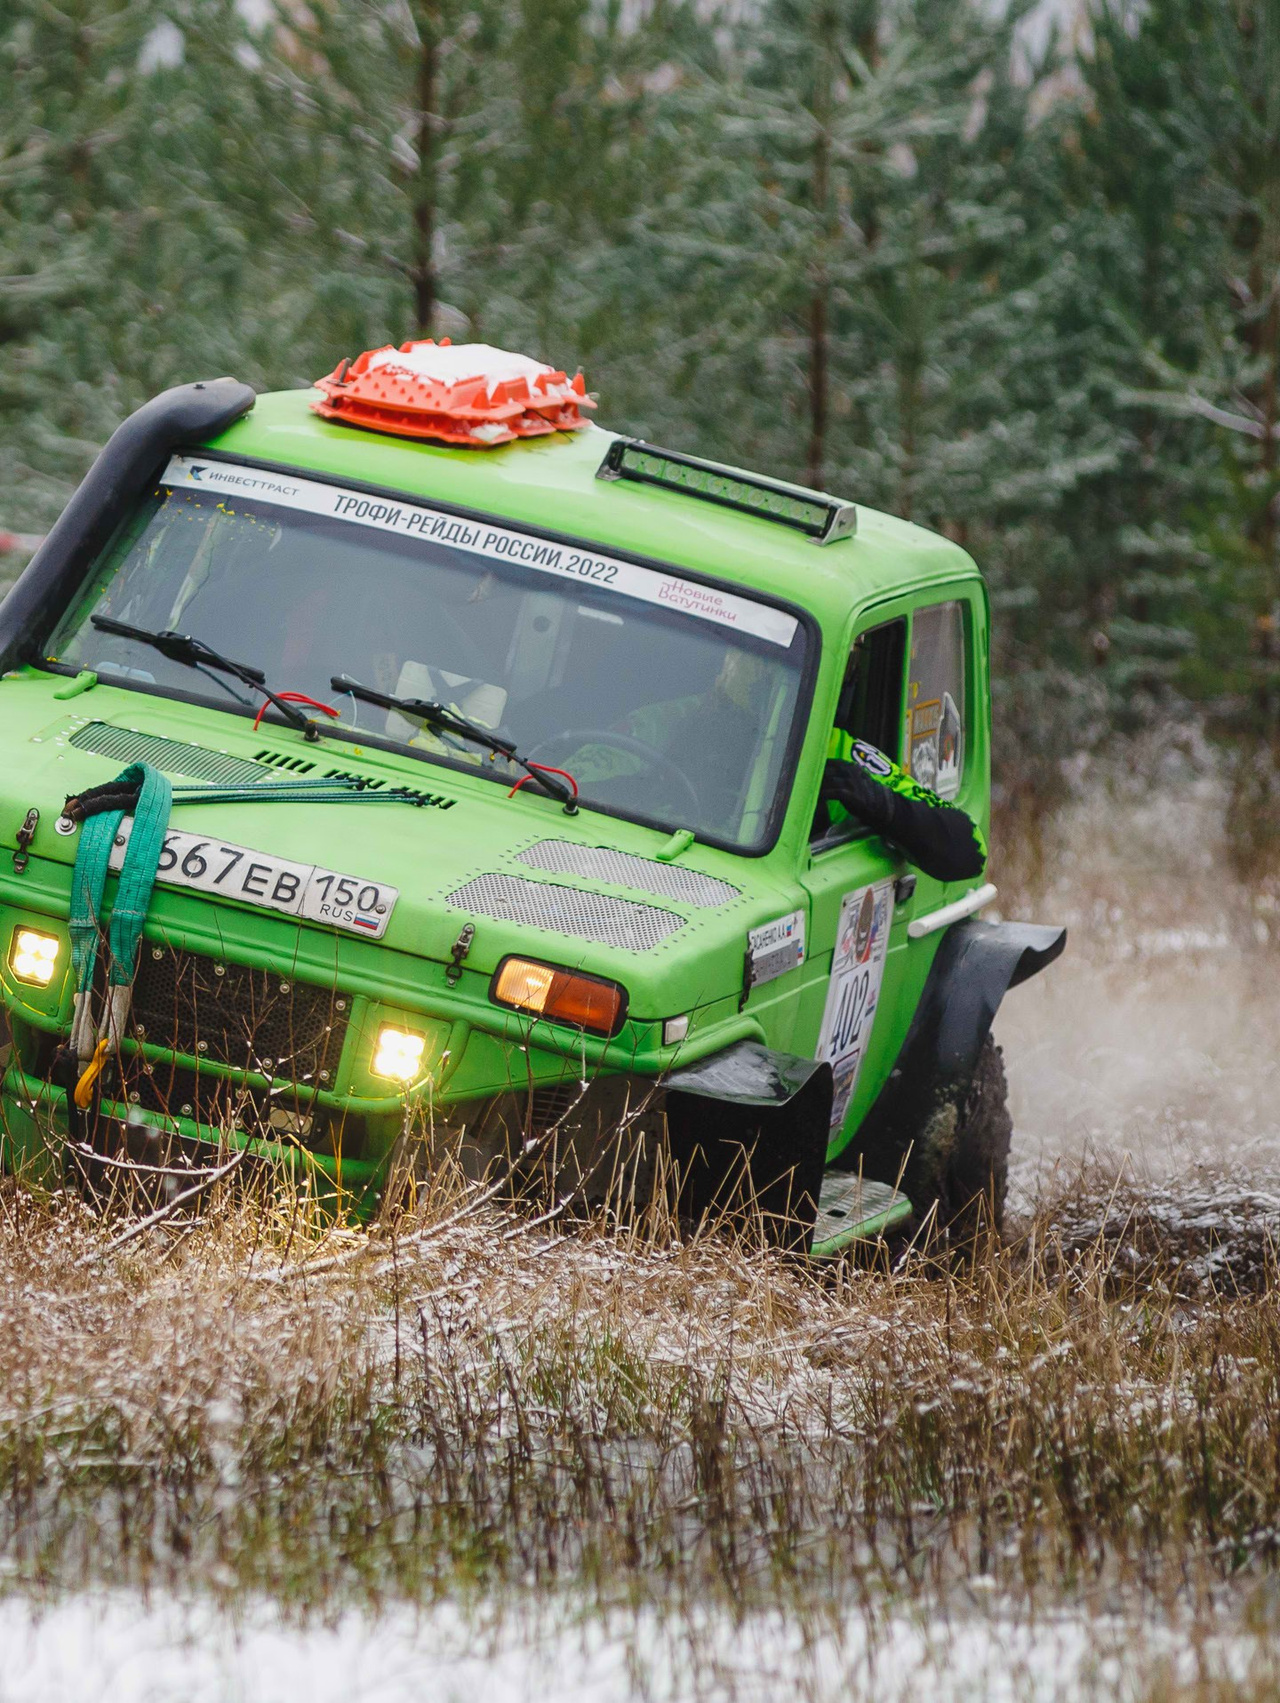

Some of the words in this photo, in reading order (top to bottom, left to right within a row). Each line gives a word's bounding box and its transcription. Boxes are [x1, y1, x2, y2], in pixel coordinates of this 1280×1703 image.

[208, 471, 300, 496] ИНВЕСТТРАСТ
[332, 494, 480, 547] ТРОФИ-РЕЙДЫ
[316, 874, 380, 912] 150
[319, 903, 353, 923] RUS
[830, 969, 870, 1058] 402
